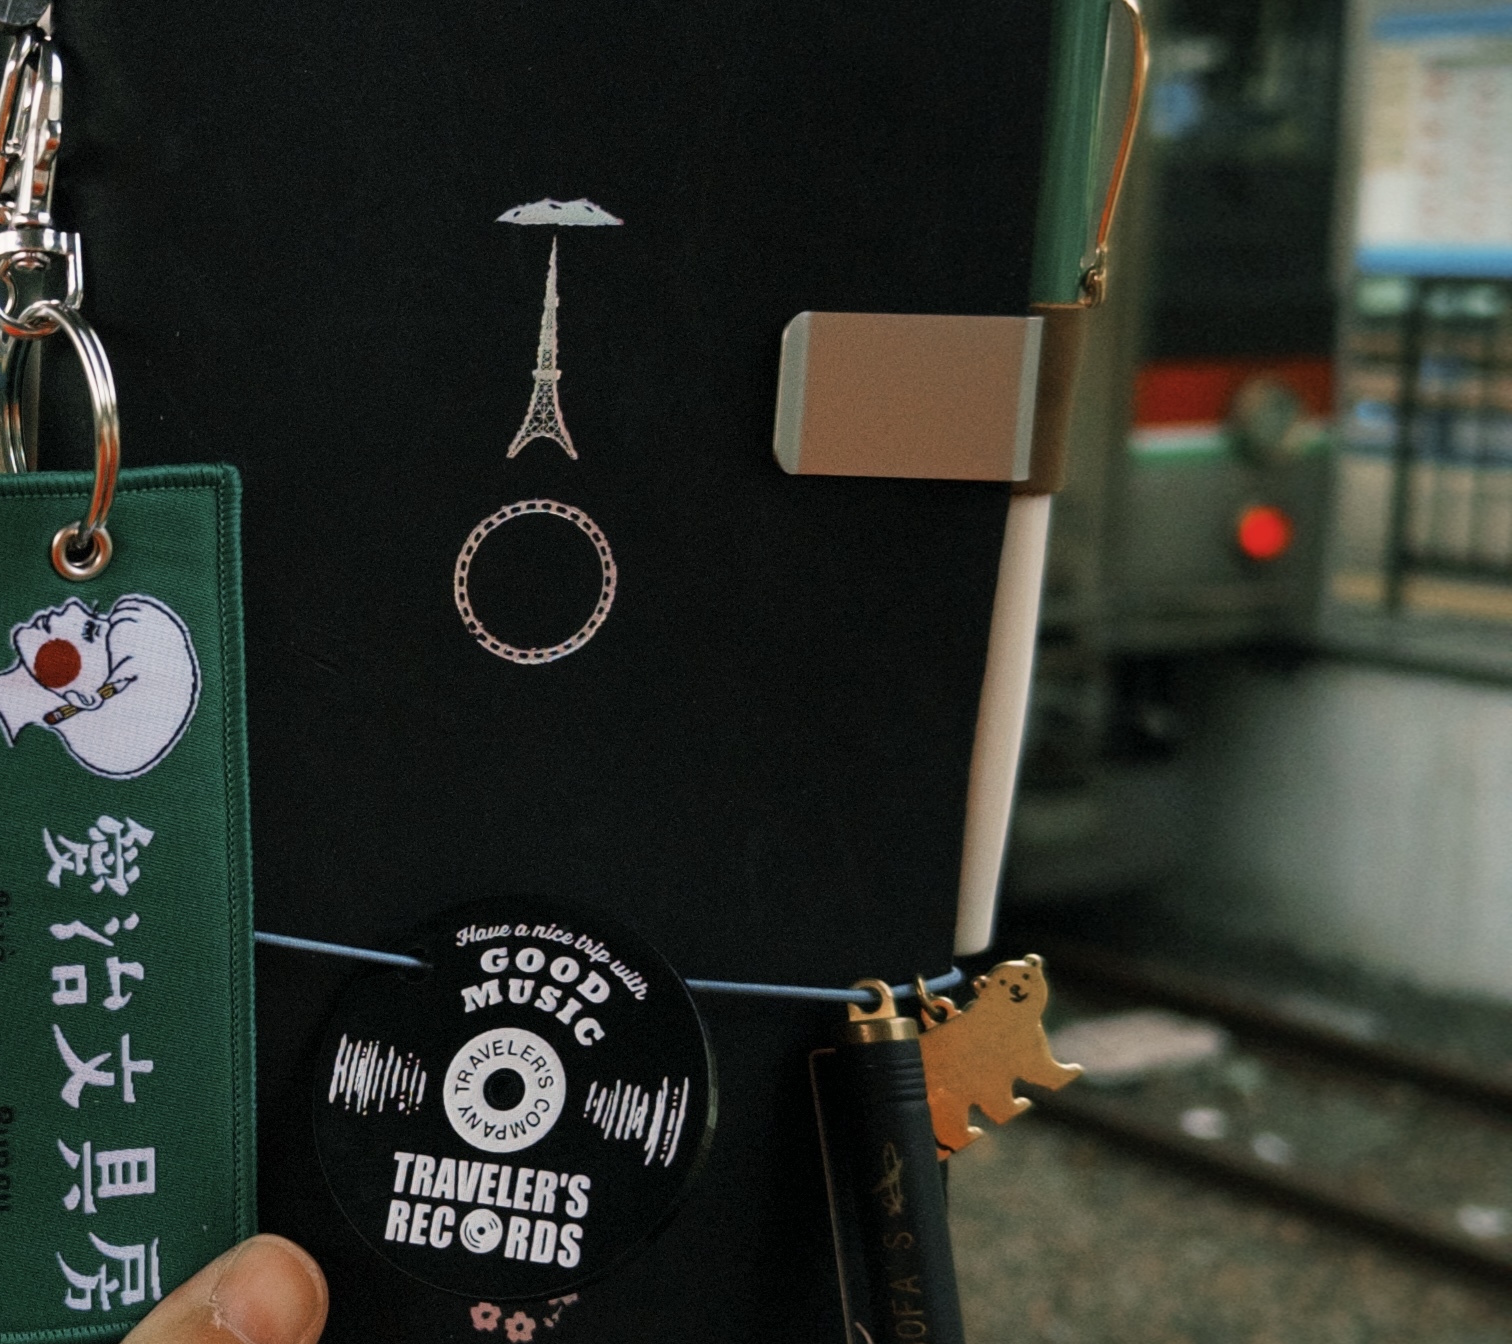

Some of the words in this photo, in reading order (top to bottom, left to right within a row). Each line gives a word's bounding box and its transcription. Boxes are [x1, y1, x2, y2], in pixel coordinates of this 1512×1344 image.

[456, 923, 512, 947] Have
[514, 923, 530, 937] a
[532, 923, 574, 945] nice
[574, 934, 610, 963] trip
[609, 960, 649, 1001] with
[480, 946, 611, 1004] GOOD
[460, 977, 606, 1046] MUSIC
[454, 1039, 555, 1096] TRAVELER'S
[457, 1098, 551, 1141] COMPANY
[393, 1151, 592, 1219] TRAVELER'S
[384, 1198, 584, 1269] RECORDS
